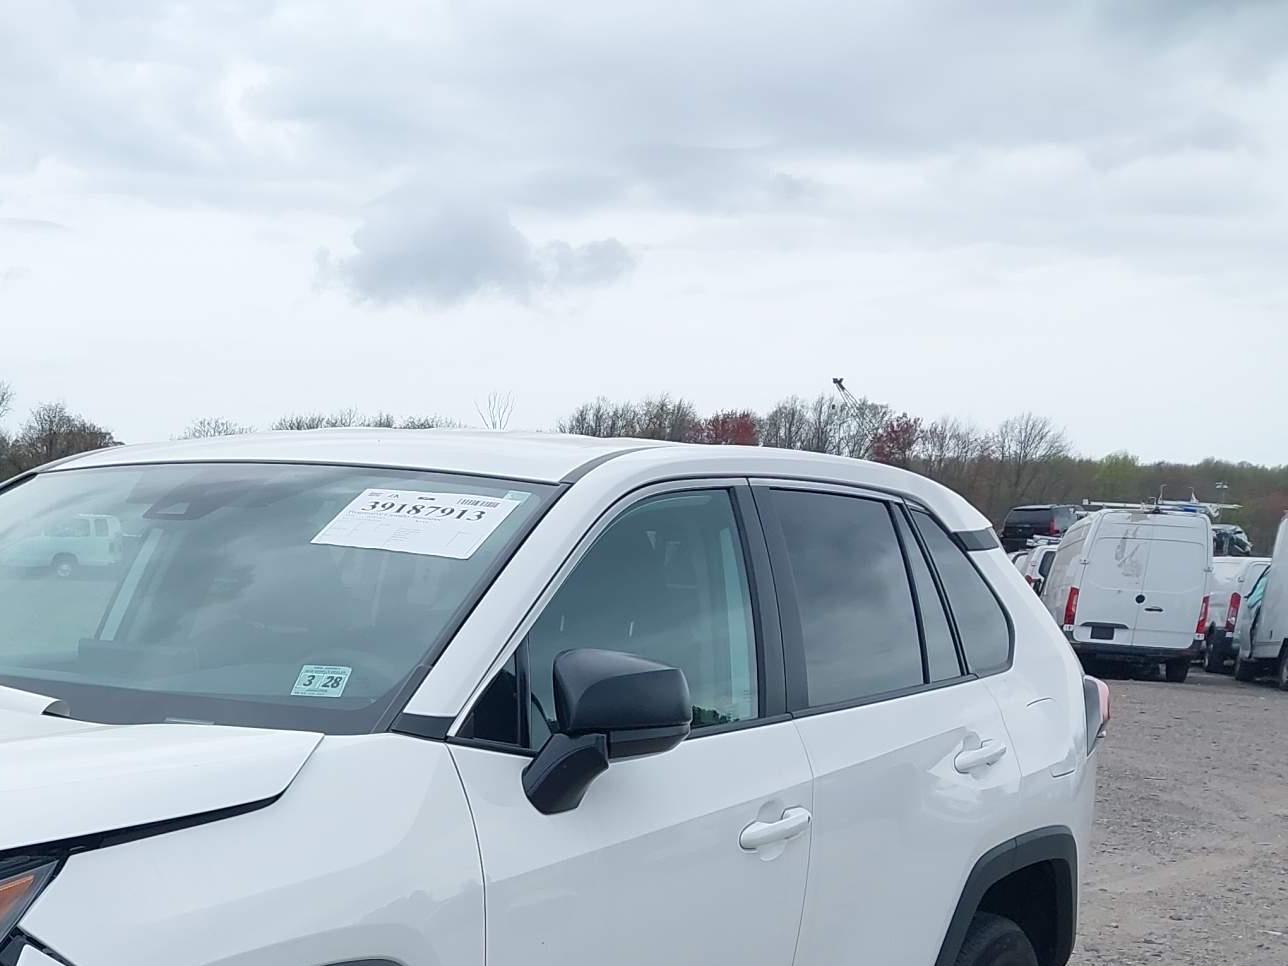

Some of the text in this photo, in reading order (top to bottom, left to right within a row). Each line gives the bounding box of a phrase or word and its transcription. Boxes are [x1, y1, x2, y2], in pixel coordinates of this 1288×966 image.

[360, 500, 486, 522] 39187913
[302, 674, 343, 689] 3 28
